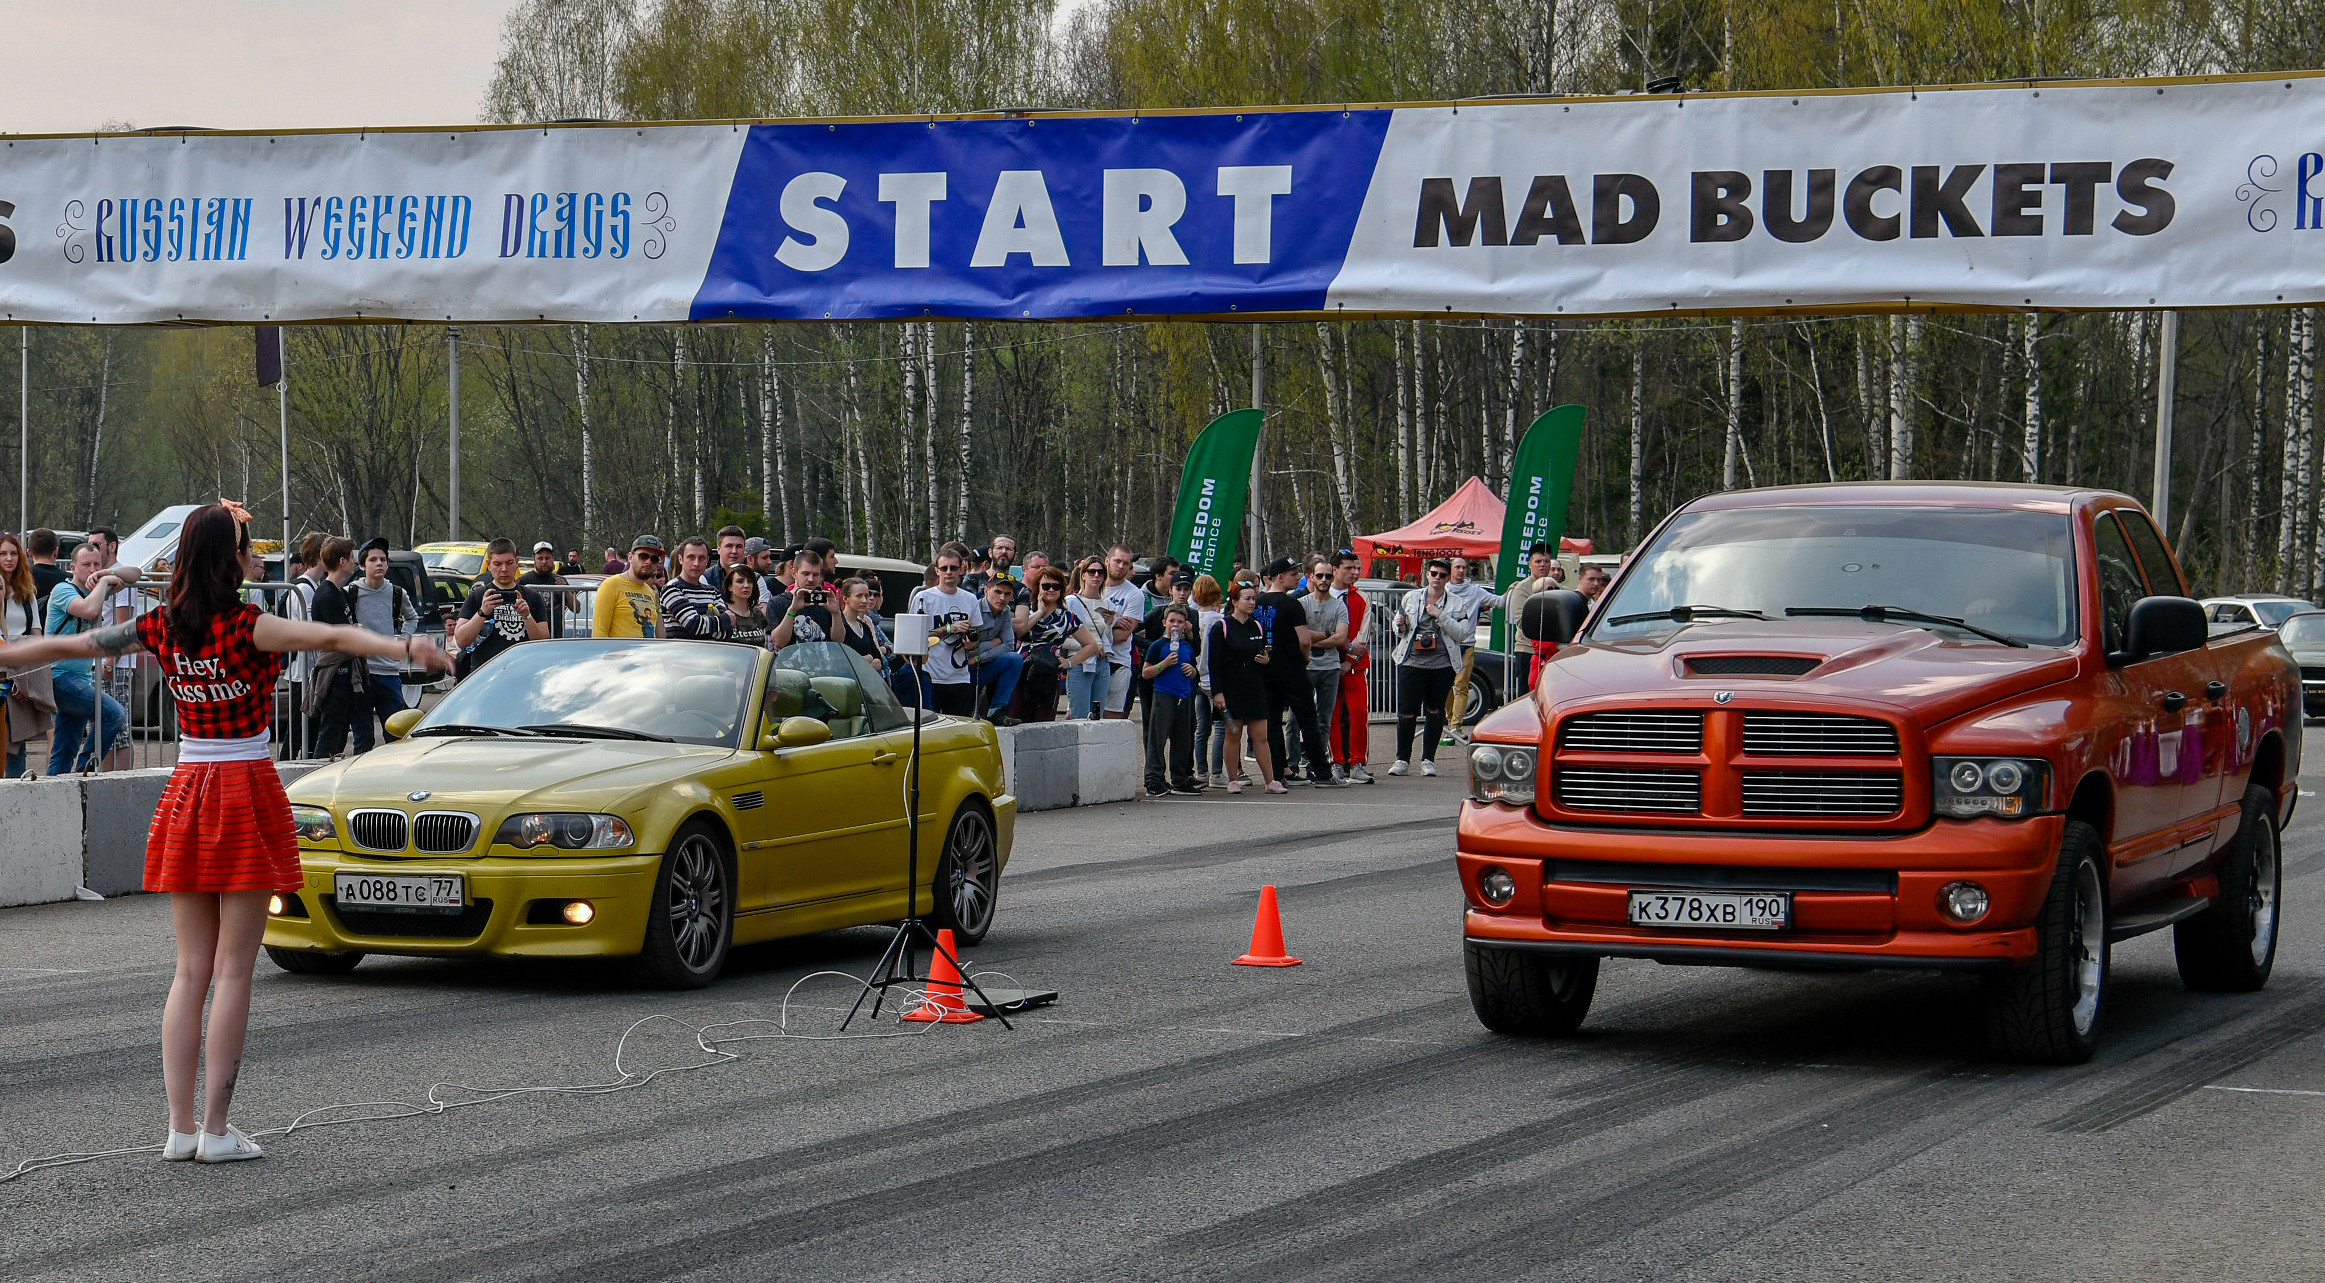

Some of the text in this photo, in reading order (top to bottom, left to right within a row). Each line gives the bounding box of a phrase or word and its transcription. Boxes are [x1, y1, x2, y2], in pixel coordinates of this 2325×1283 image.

[95, 197, 253, 263] RUSSIAN
[284, 194, 472, 261] WEEKEND
[498, 191, 632, 260] DRAGS
[774, 165, 1293, 272] START
[1413, 157, 2176, 248] MAD BUCKETS
[1516, 476, 1542, 578] FREEDOM
[173, 653, 226, 679] Hey,
[208, 680, 251, 702] me.
[432, 880, 454, 897] 77
[1638, 896, 1780, 923] К378ХВ 190
